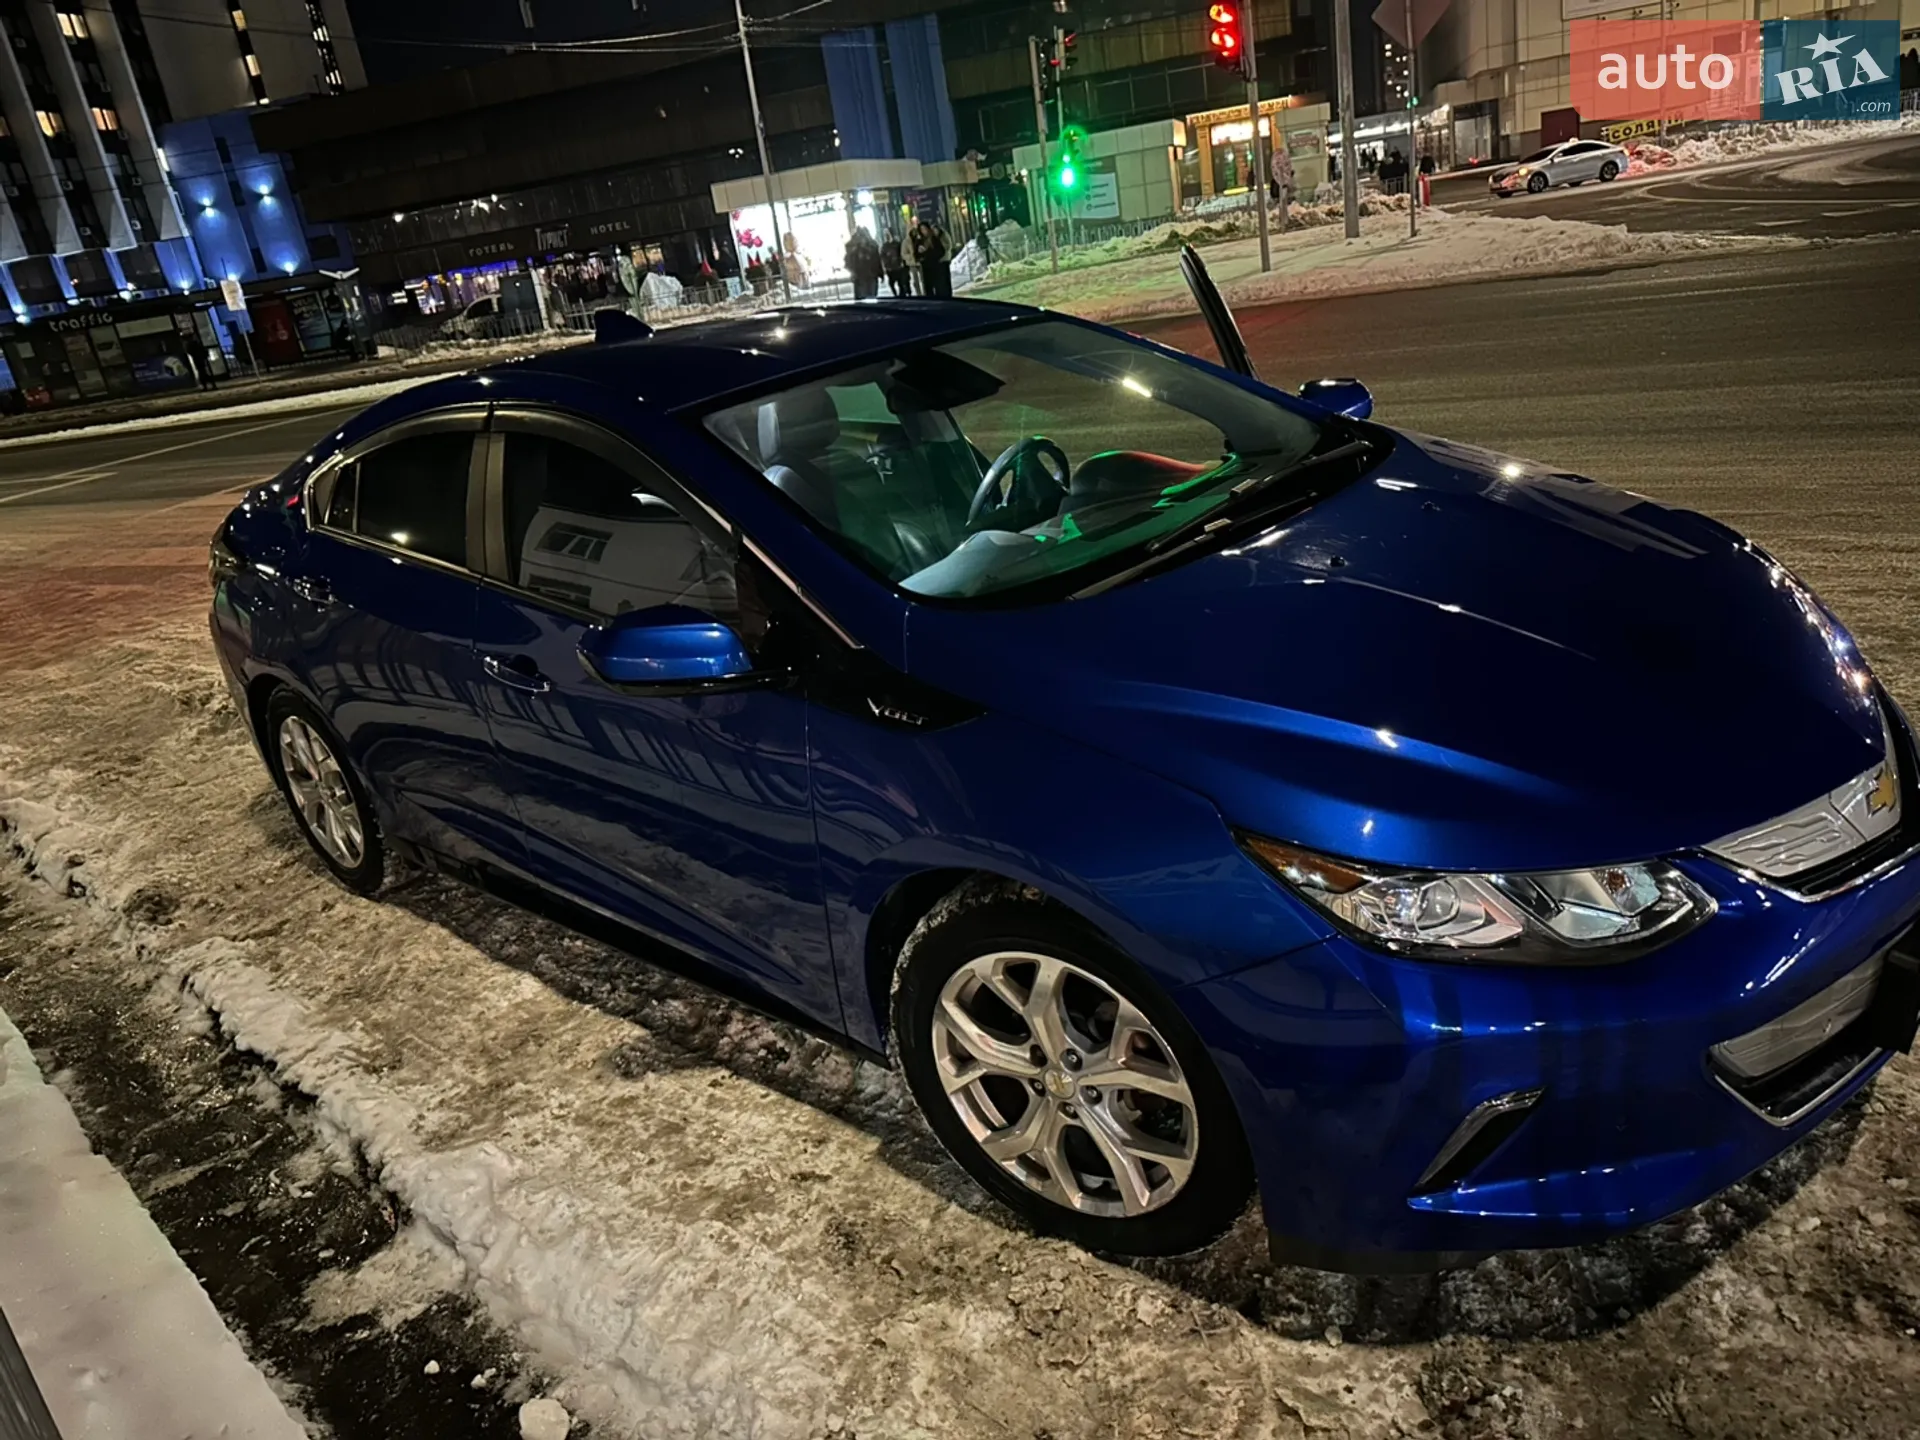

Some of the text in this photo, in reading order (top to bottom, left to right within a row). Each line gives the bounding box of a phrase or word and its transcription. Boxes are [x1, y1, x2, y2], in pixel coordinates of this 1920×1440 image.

[590, 221, 631, 235] HOTEL
[468, 242, 515, 257] ГОТЕЛЬ
[48, 312, 114, 333] traffic
